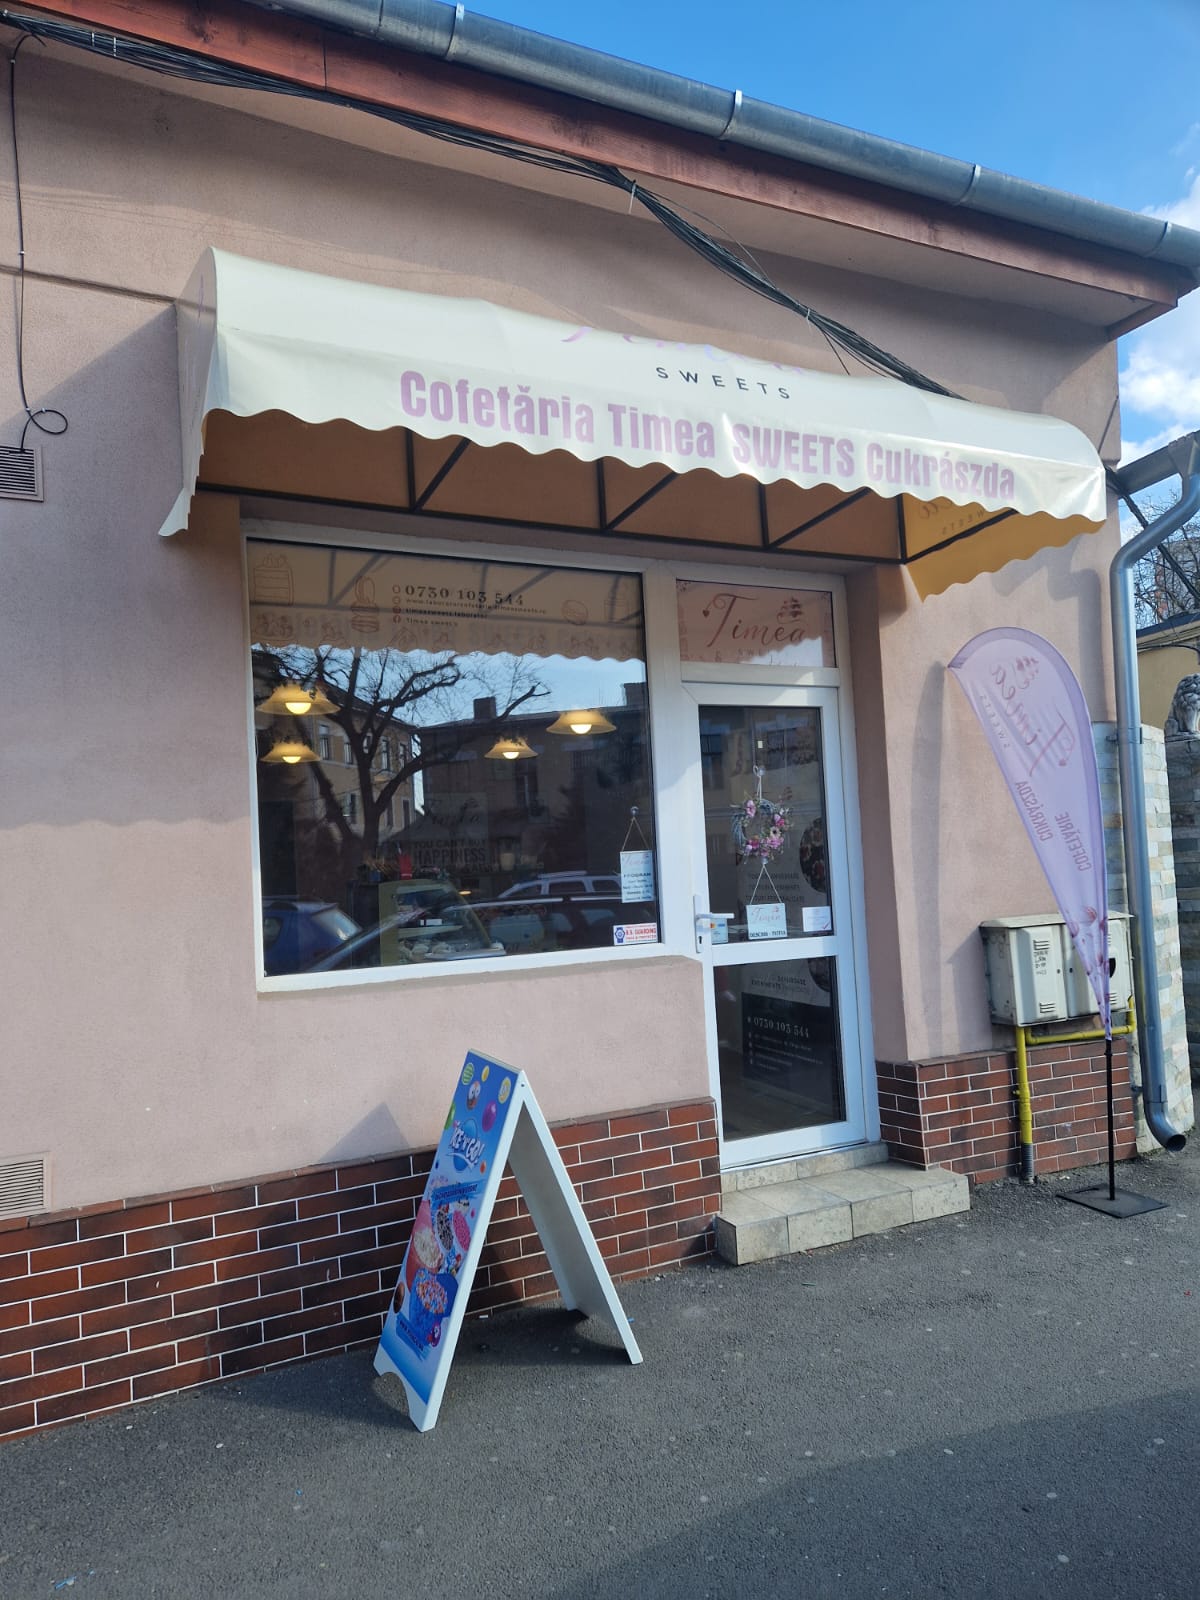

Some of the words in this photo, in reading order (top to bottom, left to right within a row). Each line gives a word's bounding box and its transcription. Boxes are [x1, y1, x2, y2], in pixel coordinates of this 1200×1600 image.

[656, 367, 790, 399] SWEETS
[400, 370, 594, 444] Cofetăria
[607, 403, 715, 458] Timea
[731, 423, 855, 478] SWEETS
[866, 442, 1015, 500] Cukrászda
[405, 585, 449, 598] 0730
[458, 590, 487, 603] 103
[495, 593, 523, 606] 544
[702, 593, 806, 647] Timea
